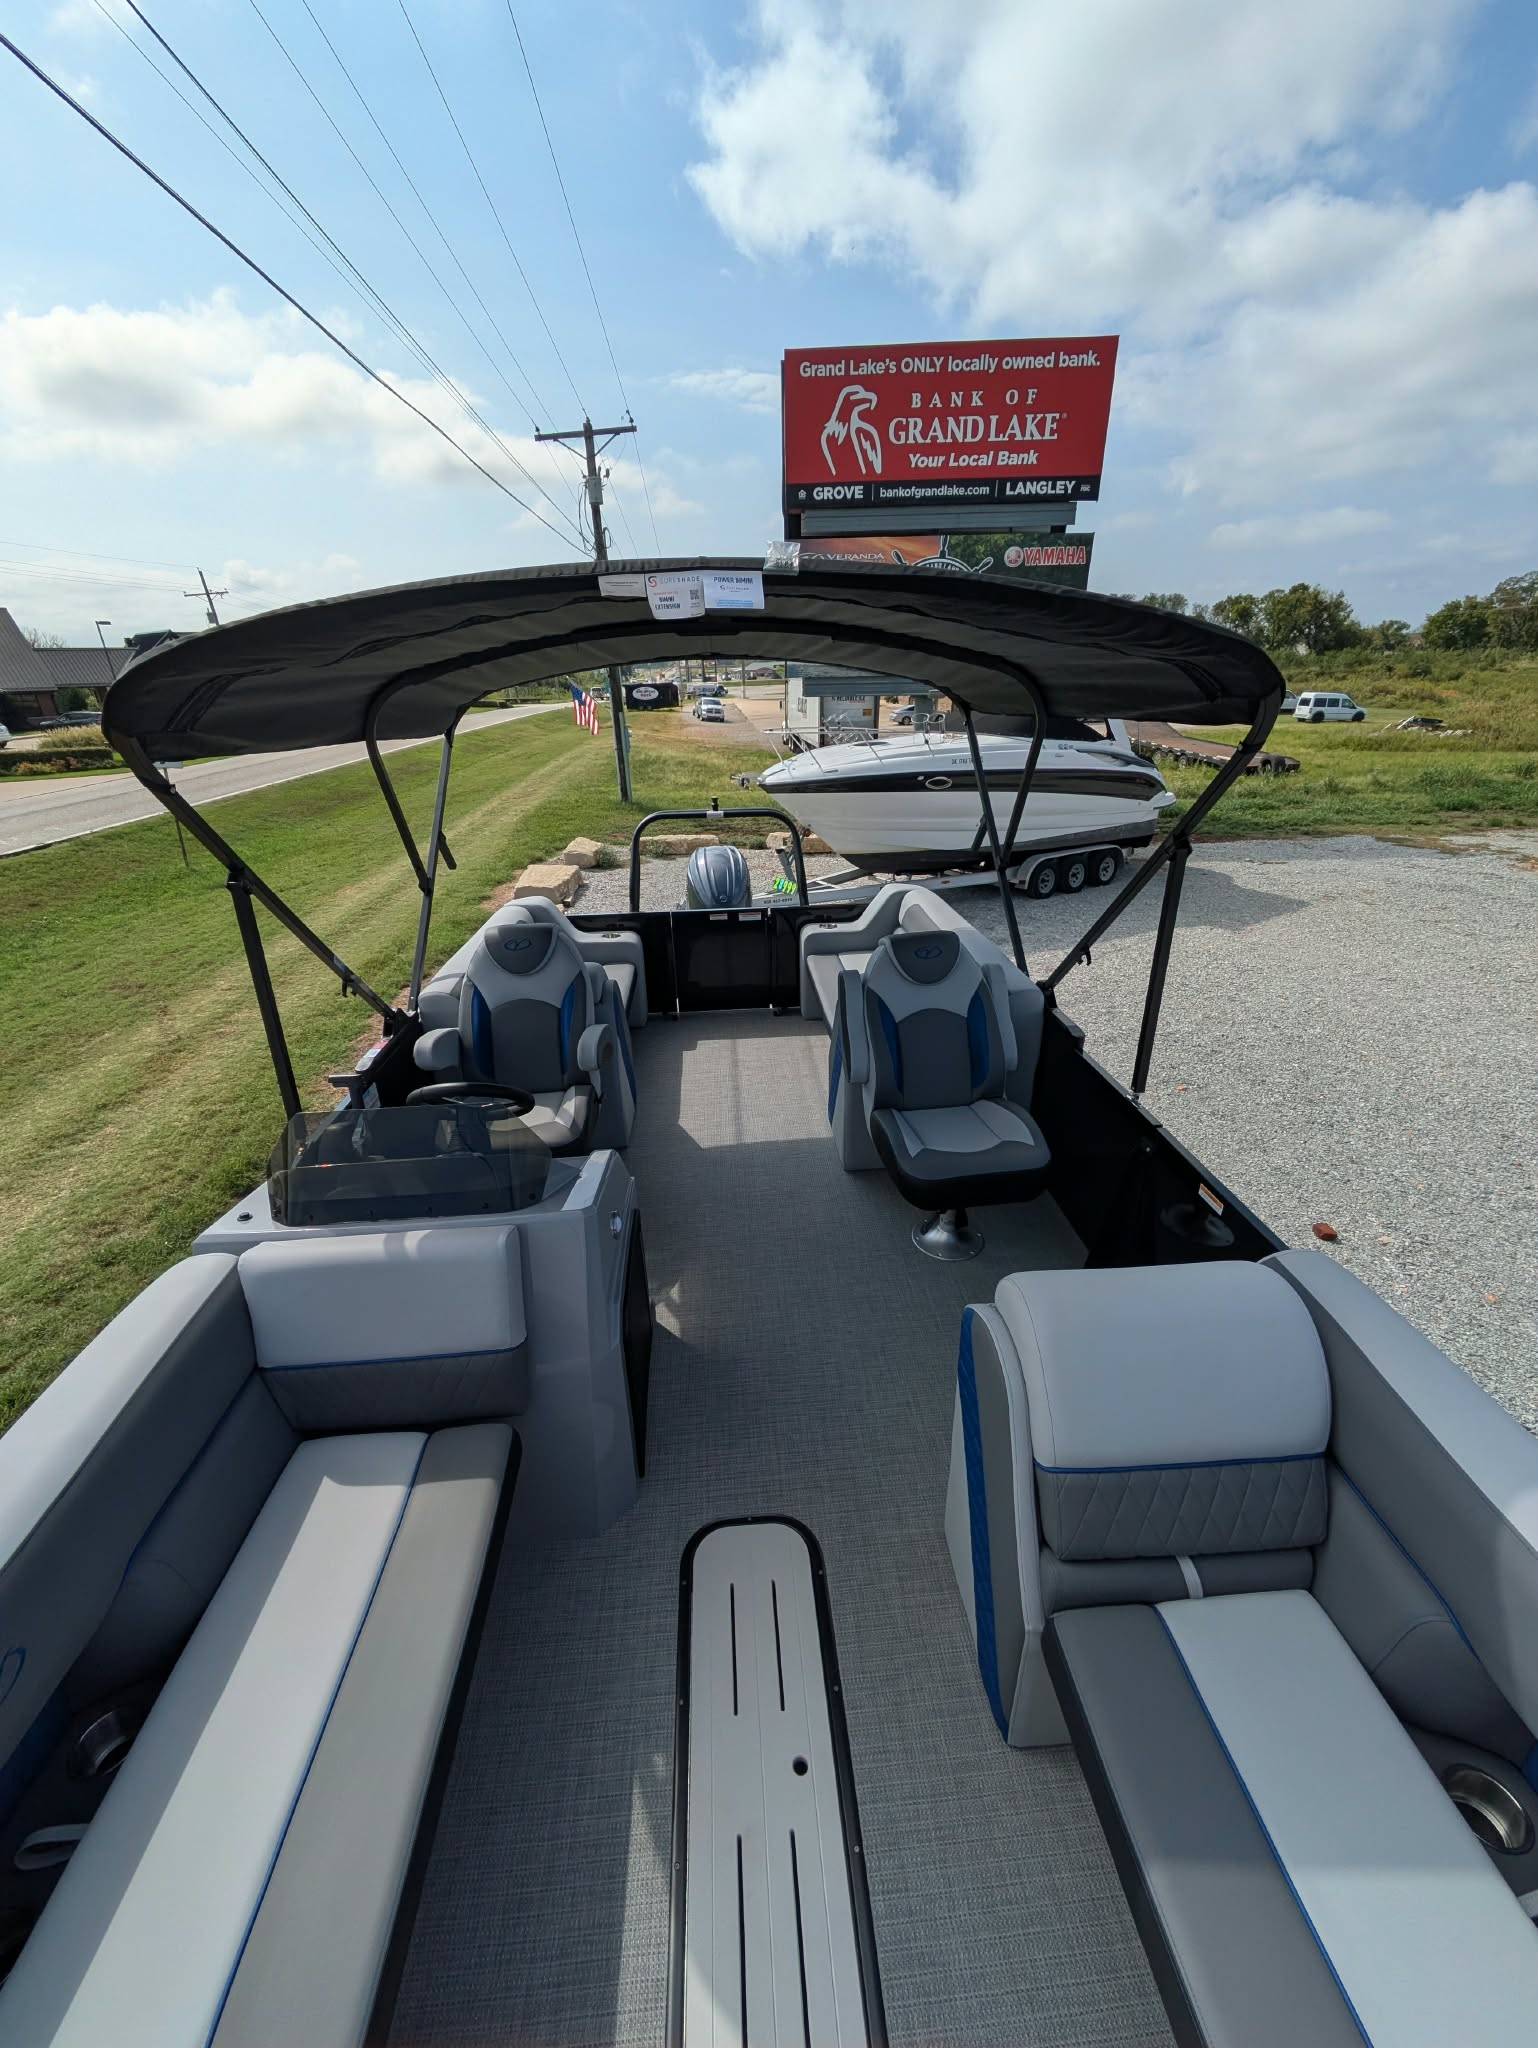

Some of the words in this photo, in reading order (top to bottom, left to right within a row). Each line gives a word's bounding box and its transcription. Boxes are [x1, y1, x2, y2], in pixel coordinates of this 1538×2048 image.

[799, 360, 845, 377] Grand
[849, 358, 897, 376] Lake's
[900, 356, 944, 373] ONLY
[947, 354, 999, 373] locally
[1002, 351, 1056, 370] owned
[1058, 350, 1101, 367] bank.
[910, 391, 984, 409] BANK
[1005, 388, 1038, 405] OF
[888, 415, 985, 445] GRAND
[987, 413, 1060, 442] LAKE
[909, 452, 946, 468] Your
[948, 450, 994, 467] Local
[997, 449, 1039, 466] Bank
[812, 485, 864, 500] GROVE
[879, 484, 990, 499] bankofgrandlake.com
[1005, 480, 1076, 496] LANGLEY
[826, 552, 885, 561] VERANDA
[1023, 545, 1087, 566] YAMAHA
